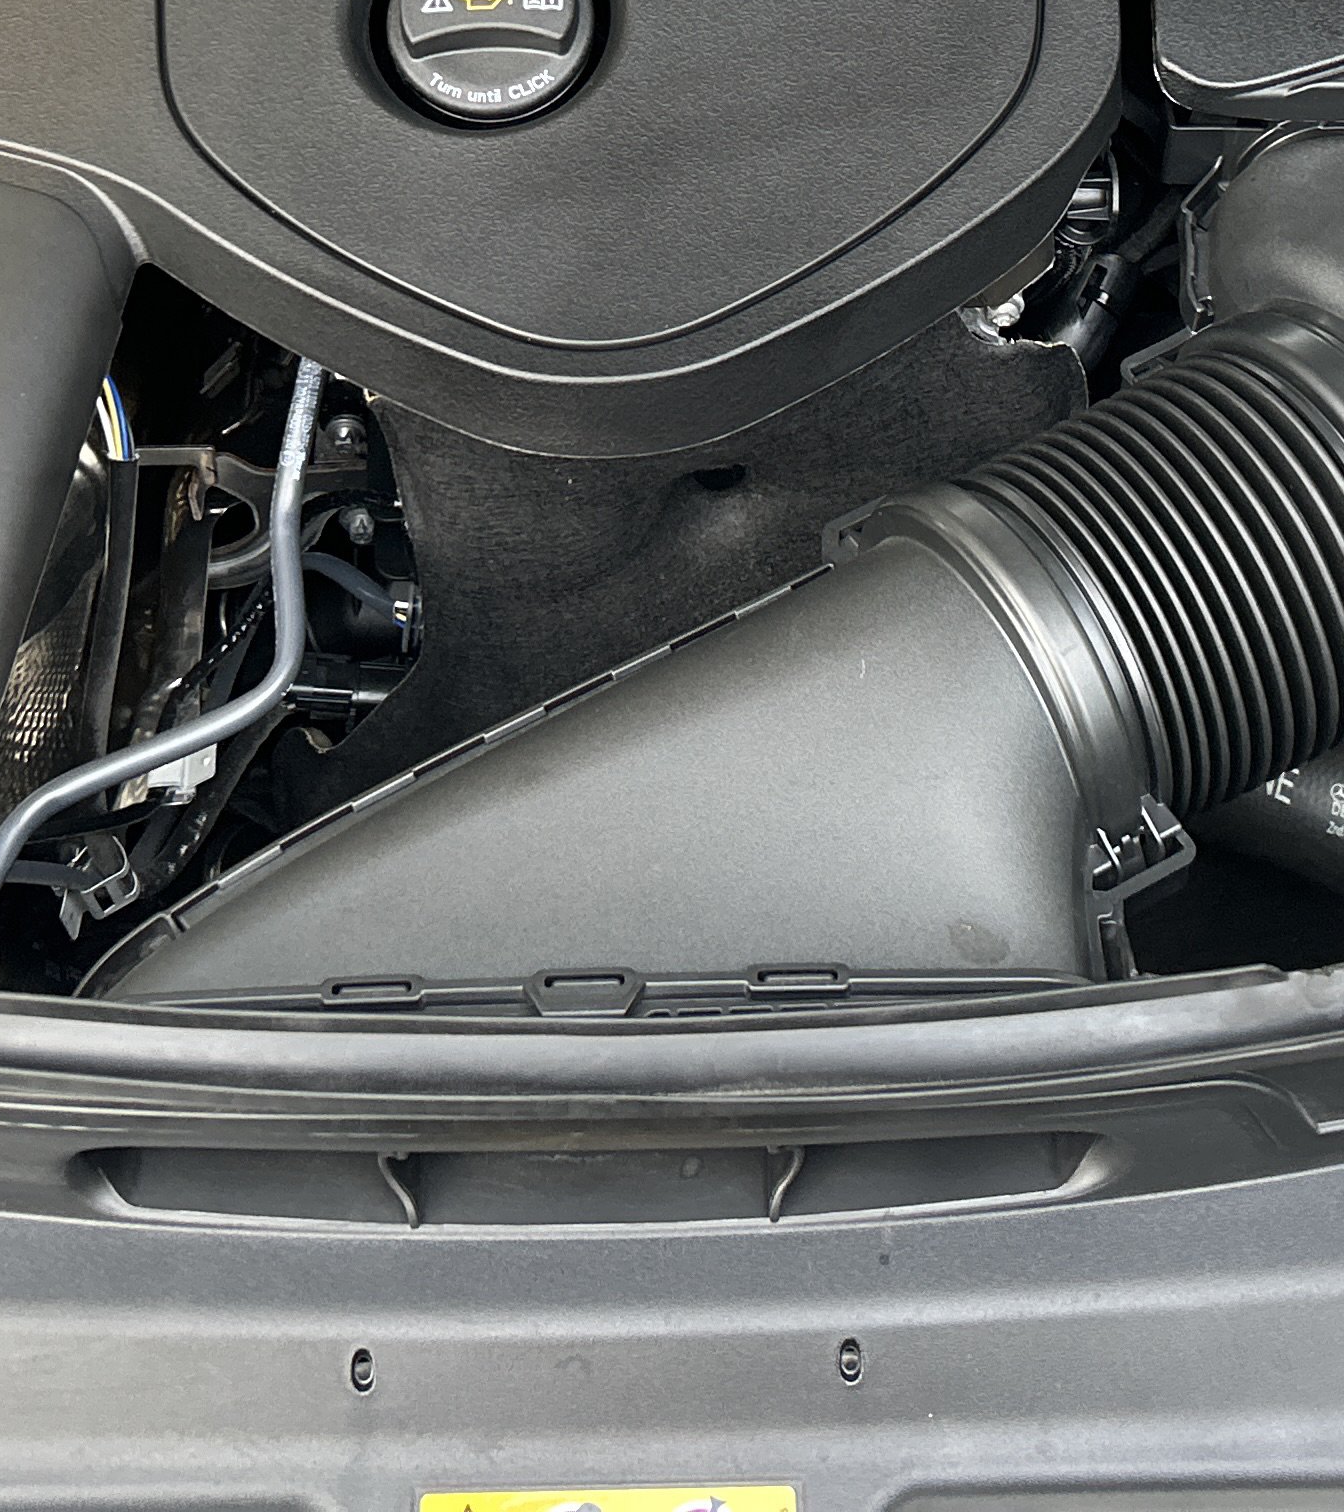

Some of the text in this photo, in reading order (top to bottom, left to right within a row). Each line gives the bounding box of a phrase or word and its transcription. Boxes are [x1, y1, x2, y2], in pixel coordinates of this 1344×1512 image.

[429, 69, 555, 103] Turn until CLICK
